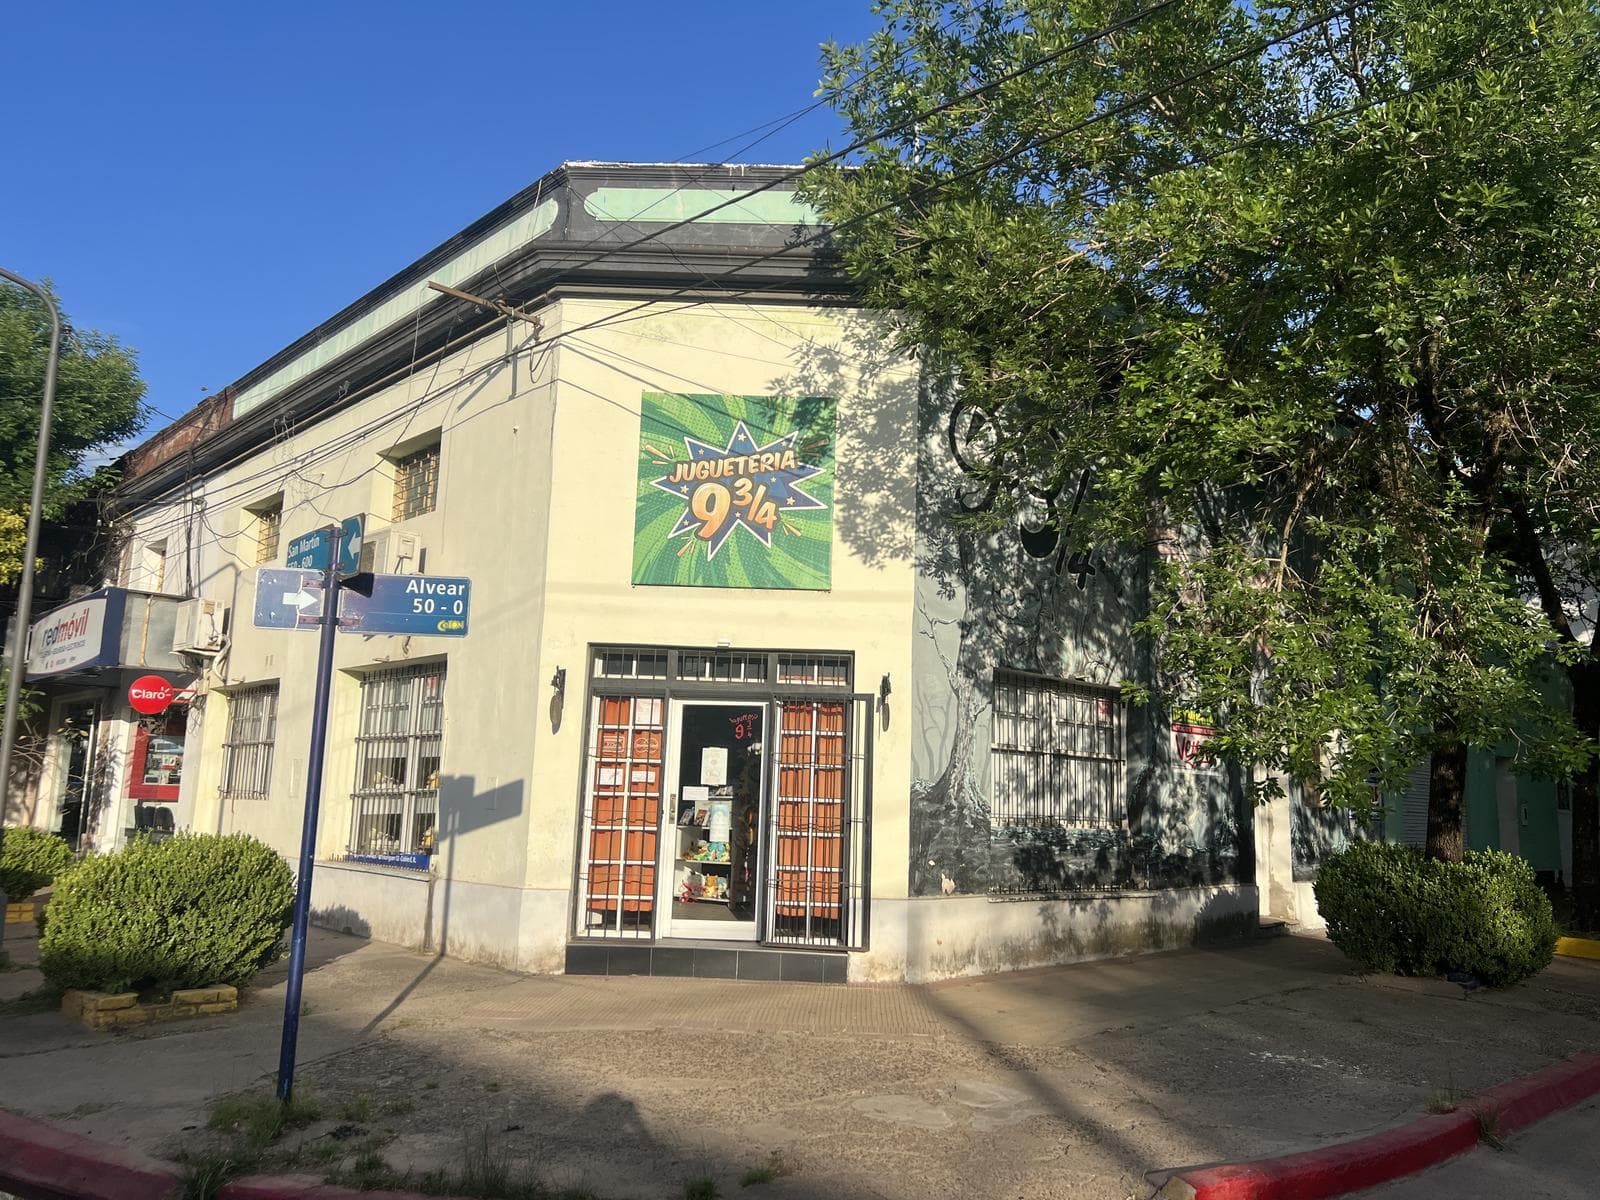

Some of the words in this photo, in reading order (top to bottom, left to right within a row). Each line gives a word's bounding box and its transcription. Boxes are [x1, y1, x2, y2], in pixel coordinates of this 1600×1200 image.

[668, 449, 797, 483] JUGUETERIA
[690, 482, 731, 539] 9
[288, 544, 299, 559] San
[299, 534, 320, 554] Martín
[302, 554, 313, 569] 600
[405, 579, 465, 596] Alvear
[412, 598, 435, 614] 50
[453, 599, 463, 615] 0
[132, 687, 166, 700] Claro
